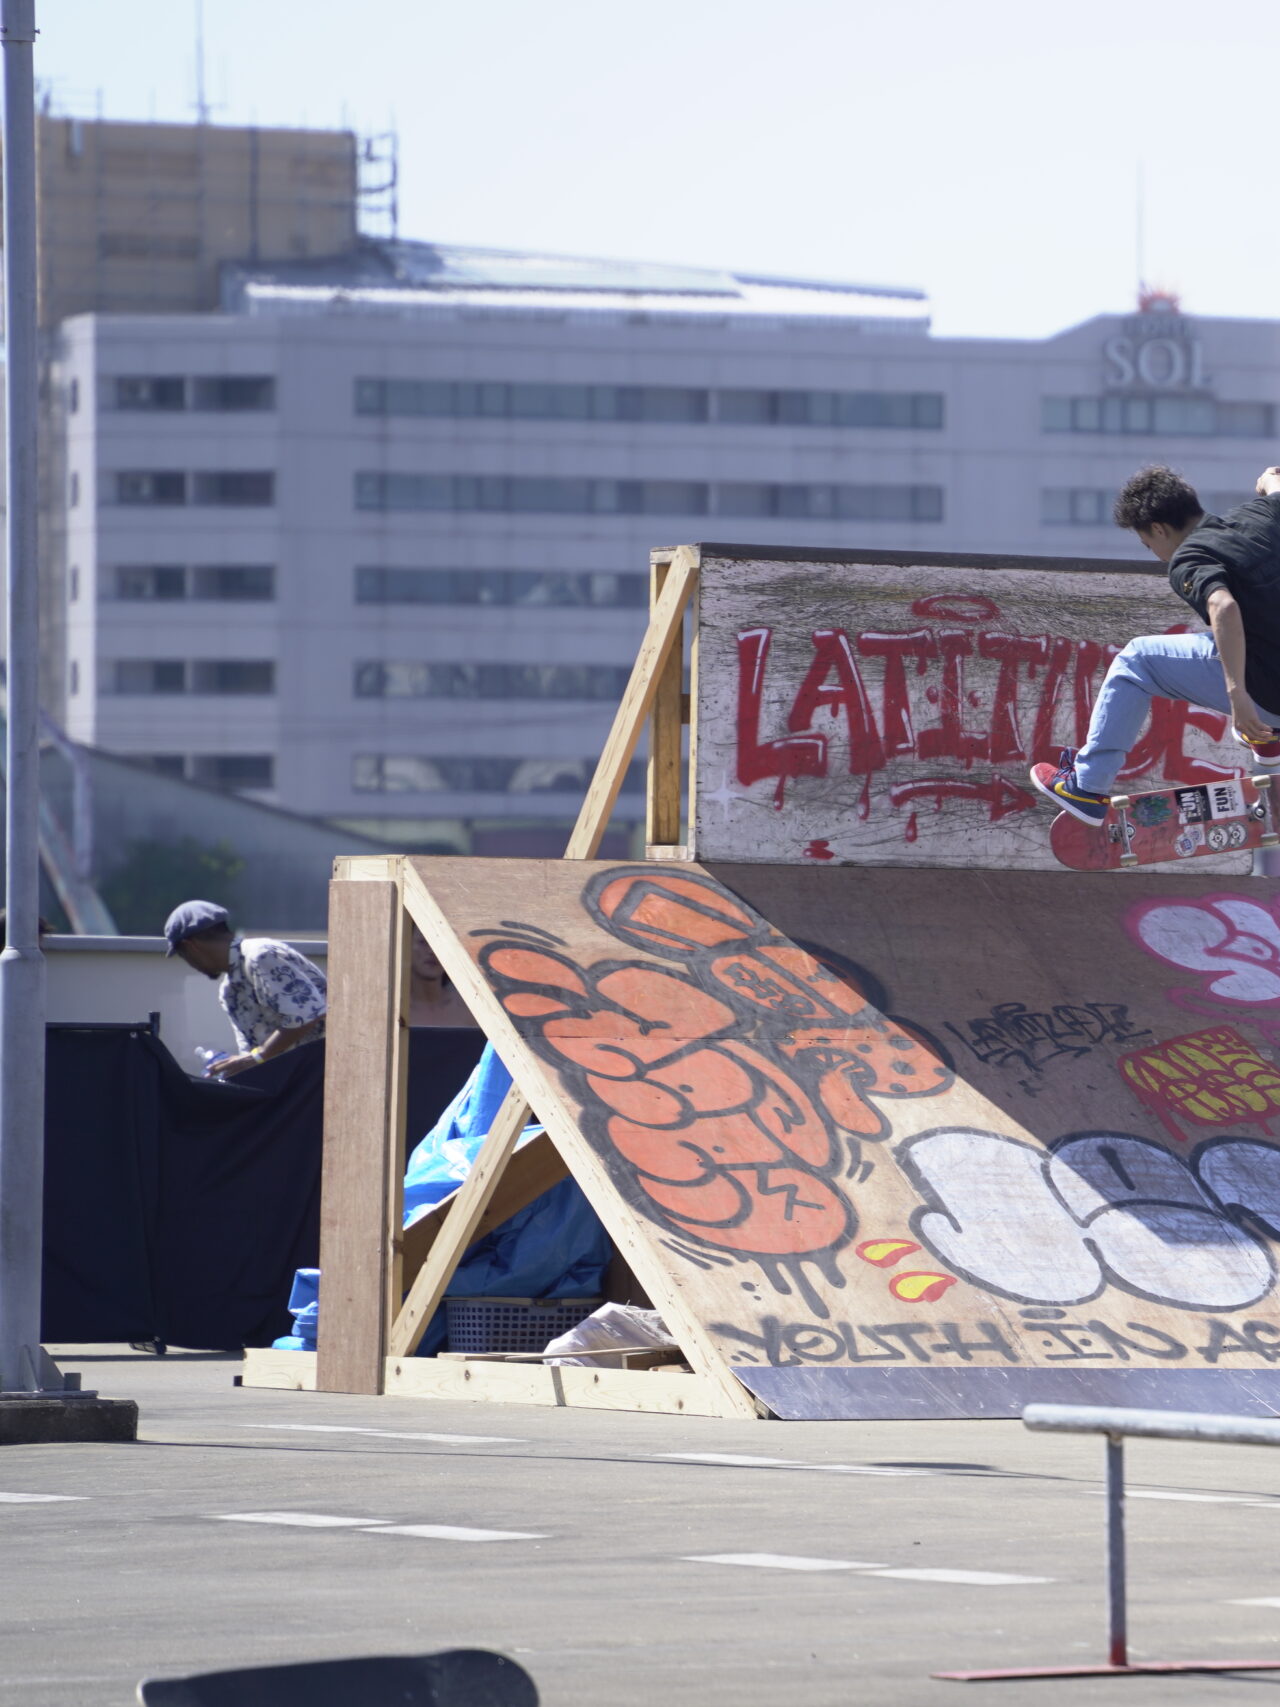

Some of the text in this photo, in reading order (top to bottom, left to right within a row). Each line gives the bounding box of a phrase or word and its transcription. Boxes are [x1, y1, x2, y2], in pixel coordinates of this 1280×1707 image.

[1181, 792, 1197, 818] FUN
[1214, 786, 1230, 812] FUN
[704, 1315, 1022, 1367] YOUTH
[1022, 1308, 1188, 1362] IN
